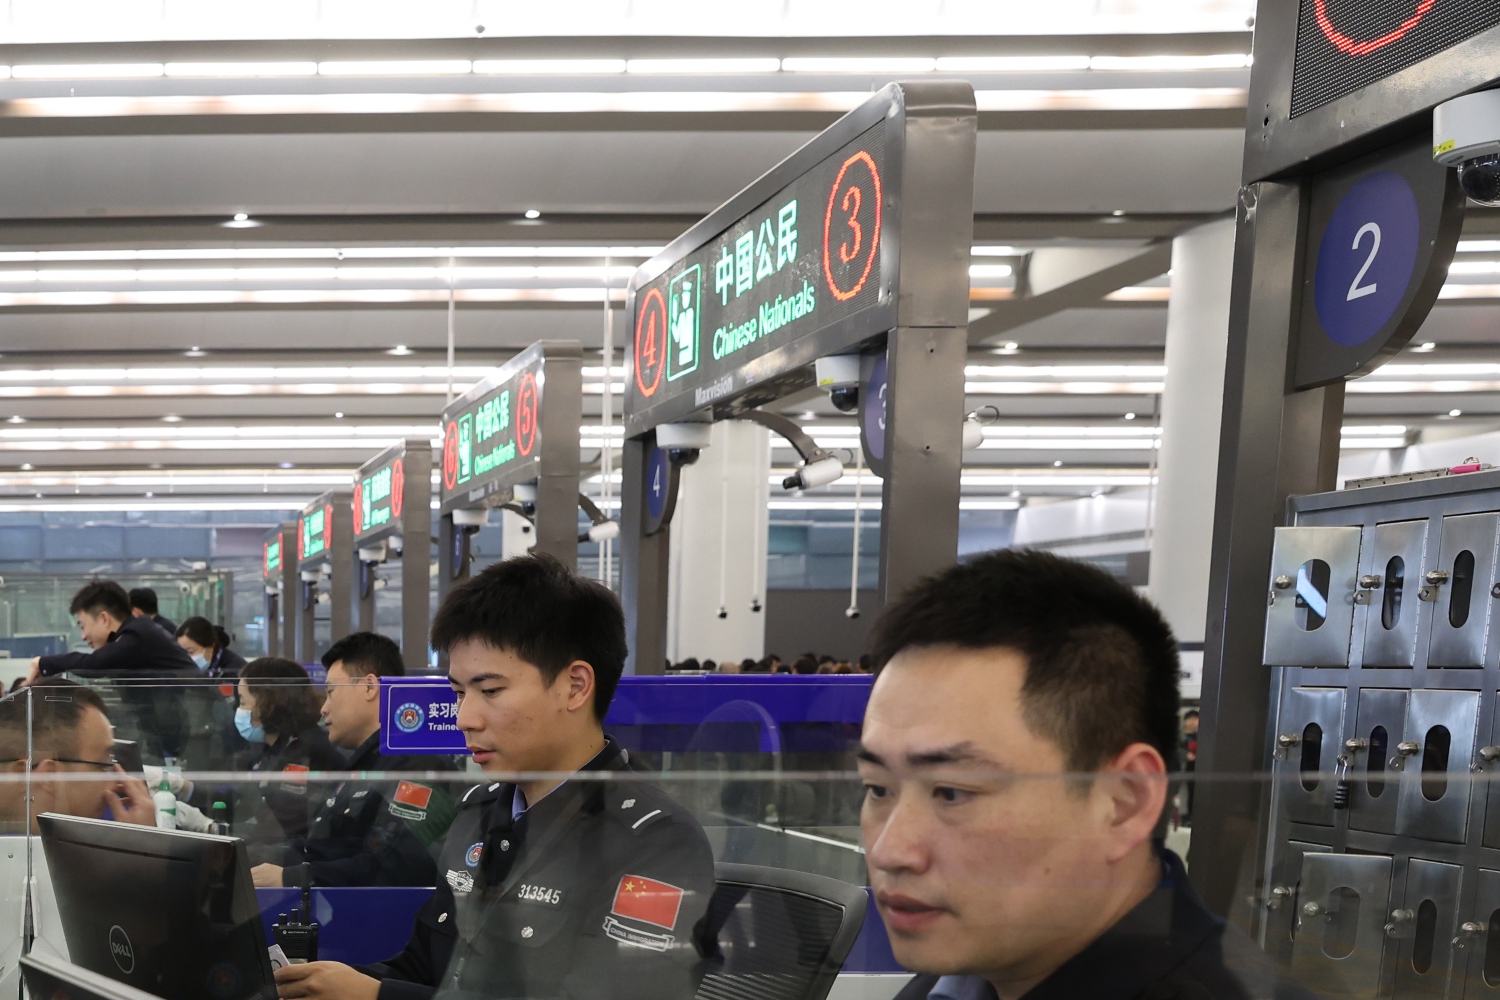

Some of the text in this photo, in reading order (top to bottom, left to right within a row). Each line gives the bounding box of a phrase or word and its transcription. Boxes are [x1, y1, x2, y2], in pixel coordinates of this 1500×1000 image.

[840, 186, 862, 262] 3
[715, 200, 797, 305] 中国公民
[1347, 222, 1381, 301] 2
[643, 311, 657, 367] 4
[712, 279, 816, 360] Chinese Nationals
[475, 390, 509, 443] 中国公民
[695, 375, 734, 407] Maxvision
[653, 465, 660, 498] 4
[518, 884, 561, 905] 313545
[112, 942, 132, 957] DELL
